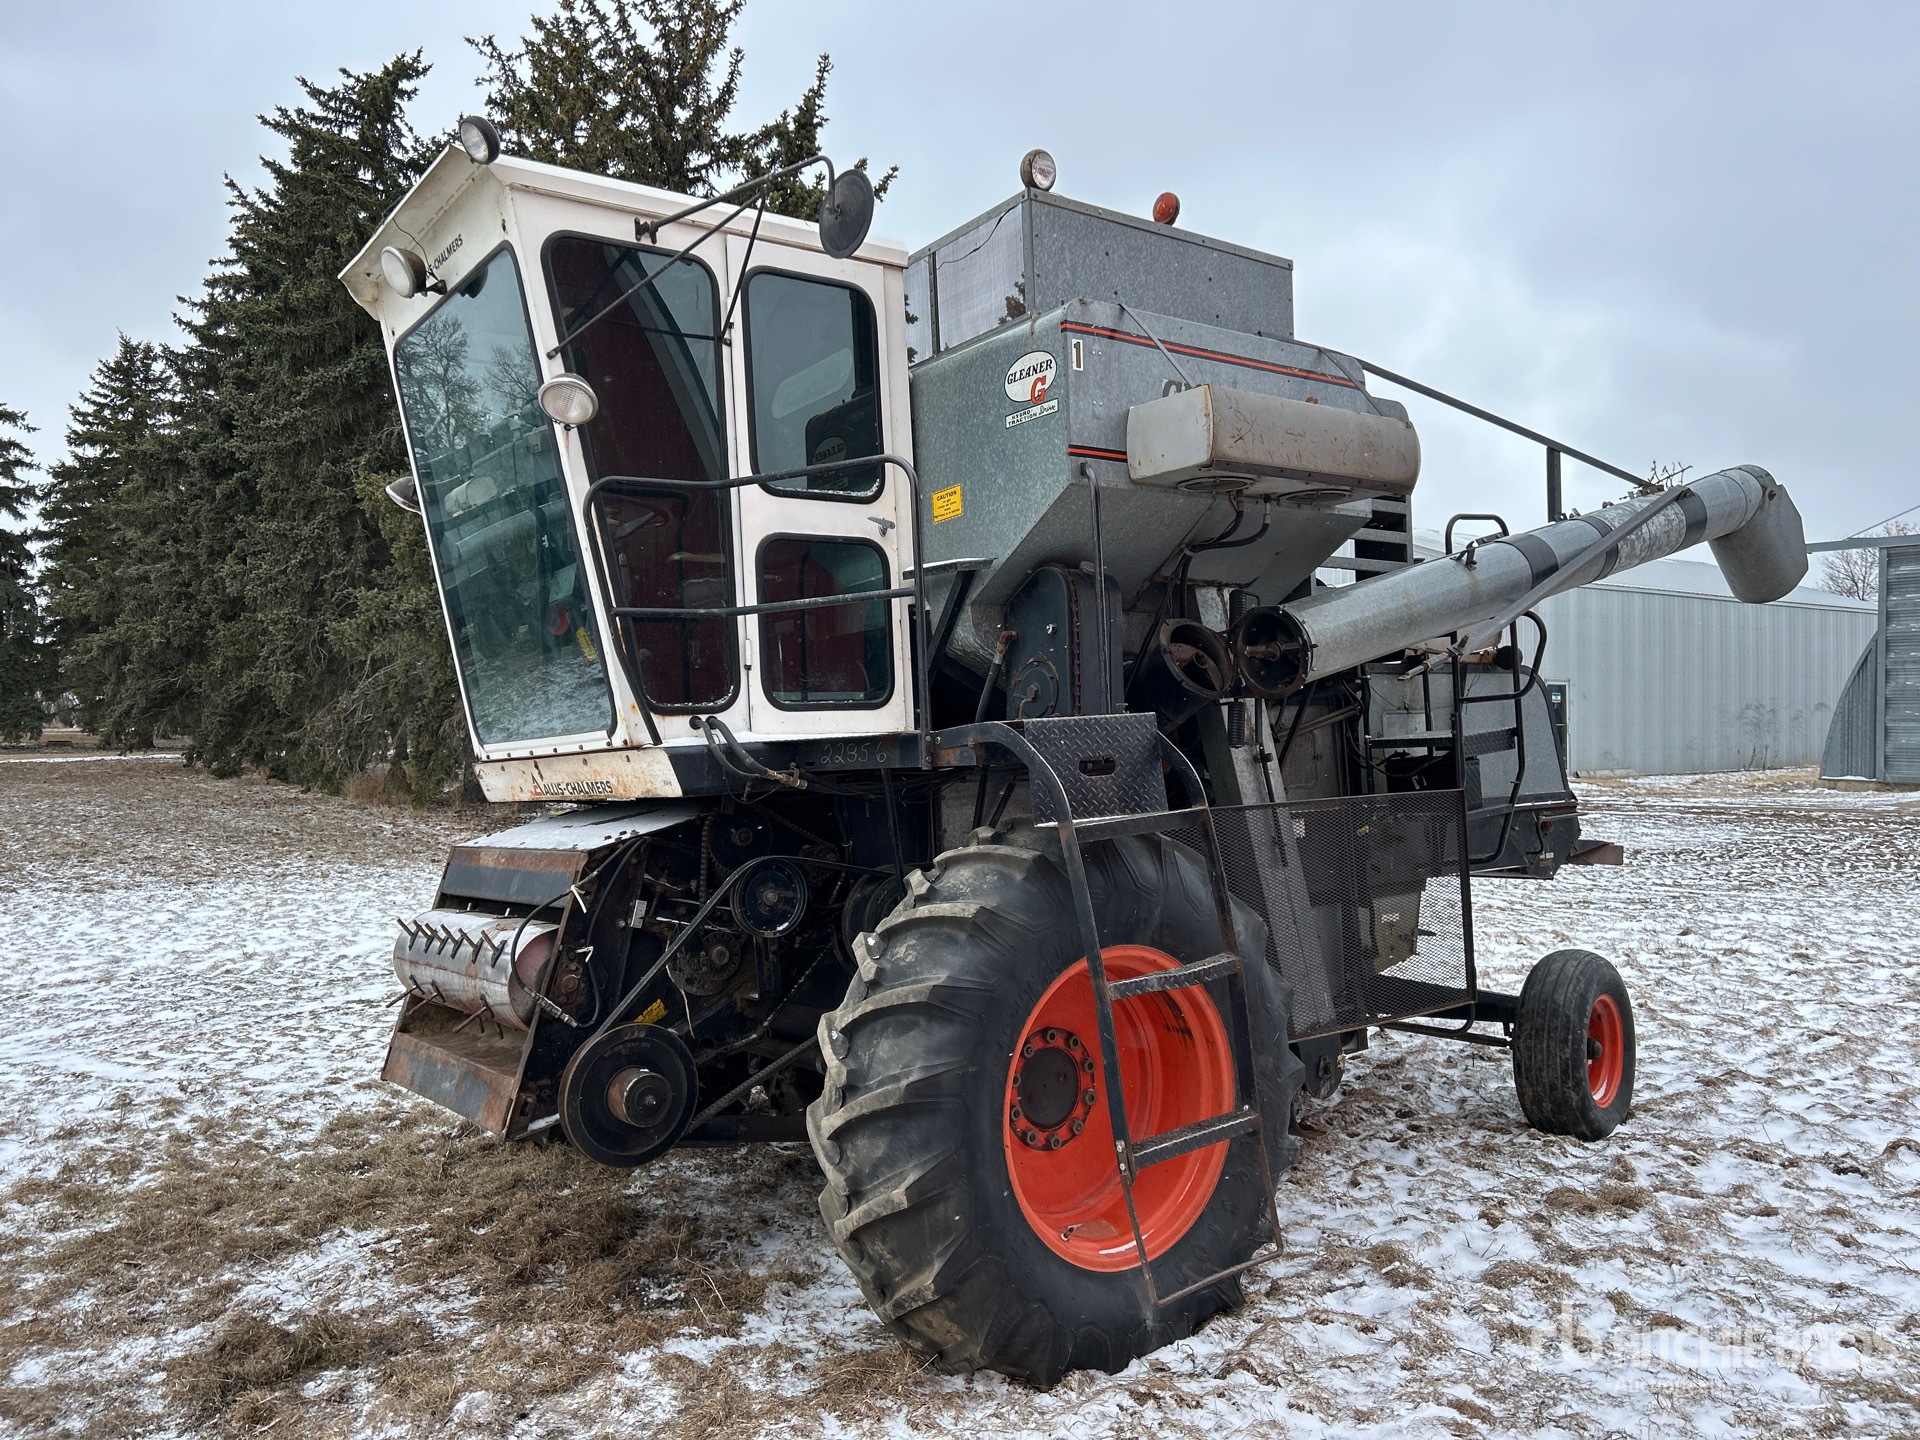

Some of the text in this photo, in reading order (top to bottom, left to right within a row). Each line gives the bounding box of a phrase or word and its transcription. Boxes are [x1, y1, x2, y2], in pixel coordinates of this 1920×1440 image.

[1073, 341, 1082, 369] 1
[1007, 358, 1053, 385] GLEANER
[1030, 374, 1047, 405] G
[936, 490, 957, 502] CAUTION
